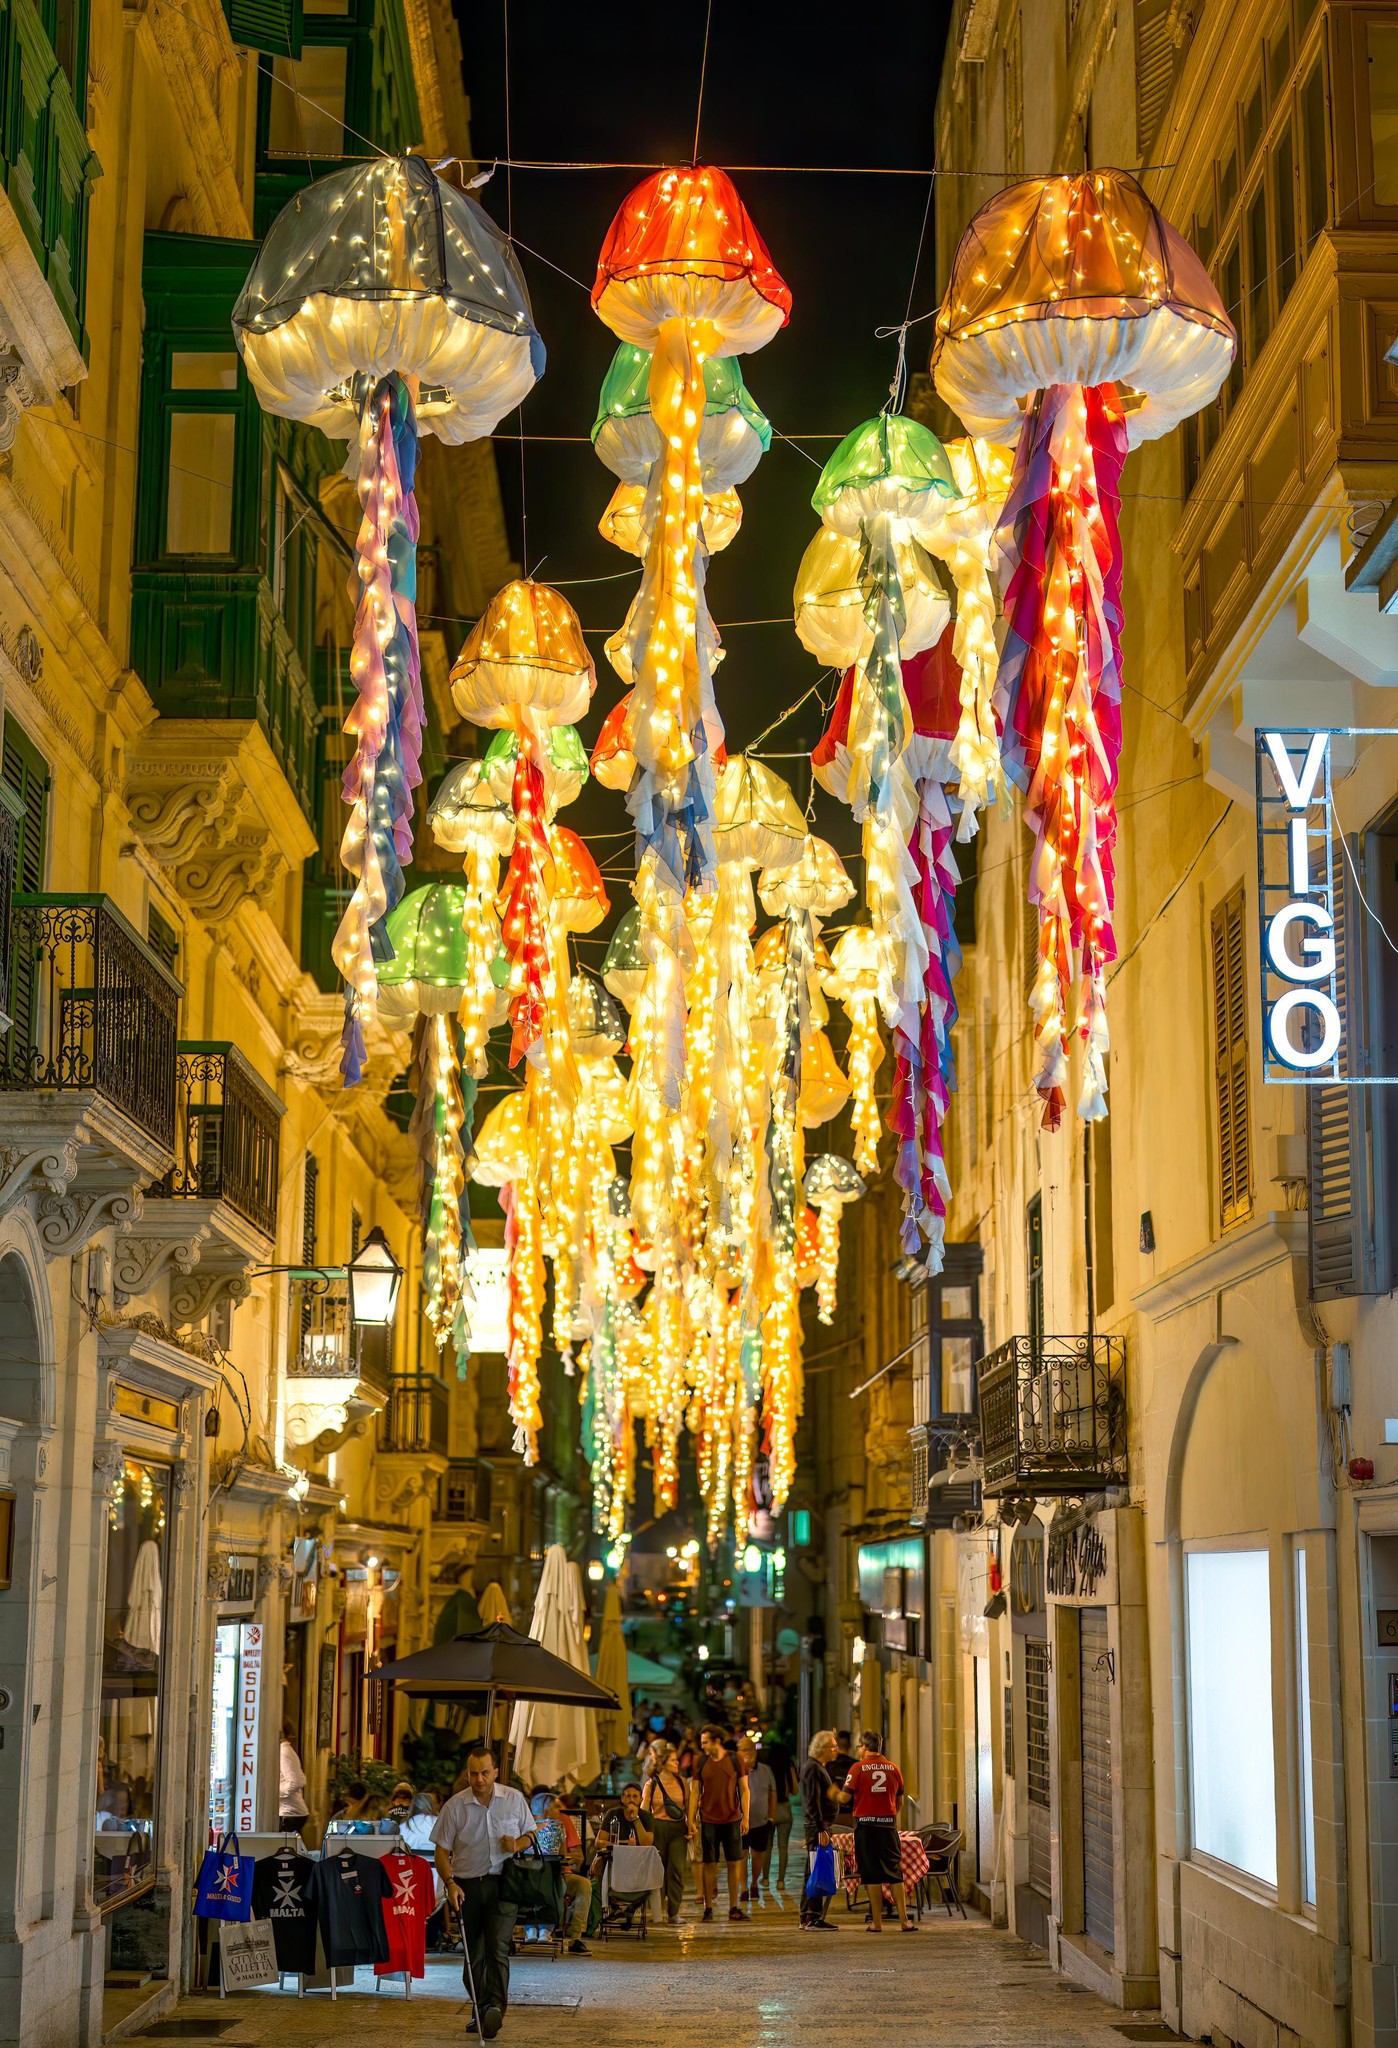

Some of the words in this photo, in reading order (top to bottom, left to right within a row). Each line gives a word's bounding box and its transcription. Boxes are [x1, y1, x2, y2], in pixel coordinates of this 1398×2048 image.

[1262, 733, 1341, 1068] VIGO
[240, 1671, 257, 1831] SOUVENIRS
[845, 1774, 852, 1785] 2
[871, 1771, 887, 1792] 2
[269, 1908, 306, 1918] MALTA
[228, 1958, 274, 1976] VALLETTA
[231, 1953, 253, 1966] CITY
[255, 1951, 268, 1961] OF
